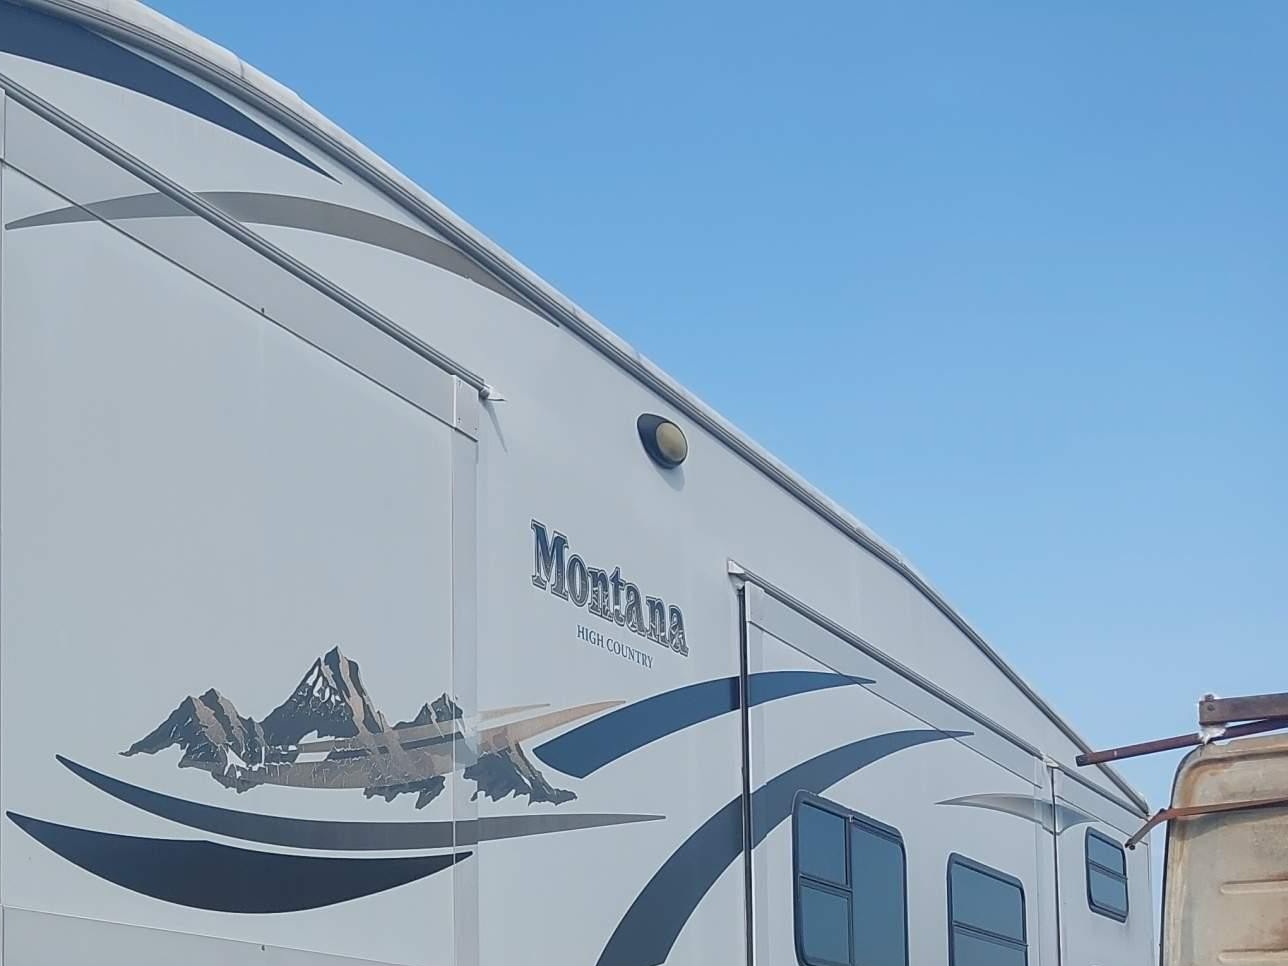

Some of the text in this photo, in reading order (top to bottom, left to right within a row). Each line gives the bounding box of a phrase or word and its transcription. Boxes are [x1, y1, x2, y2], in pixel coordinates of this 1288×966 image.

[531, 518, 689, 657] Montana
[577, 624, 654, 669] HIGH COUNTRY
